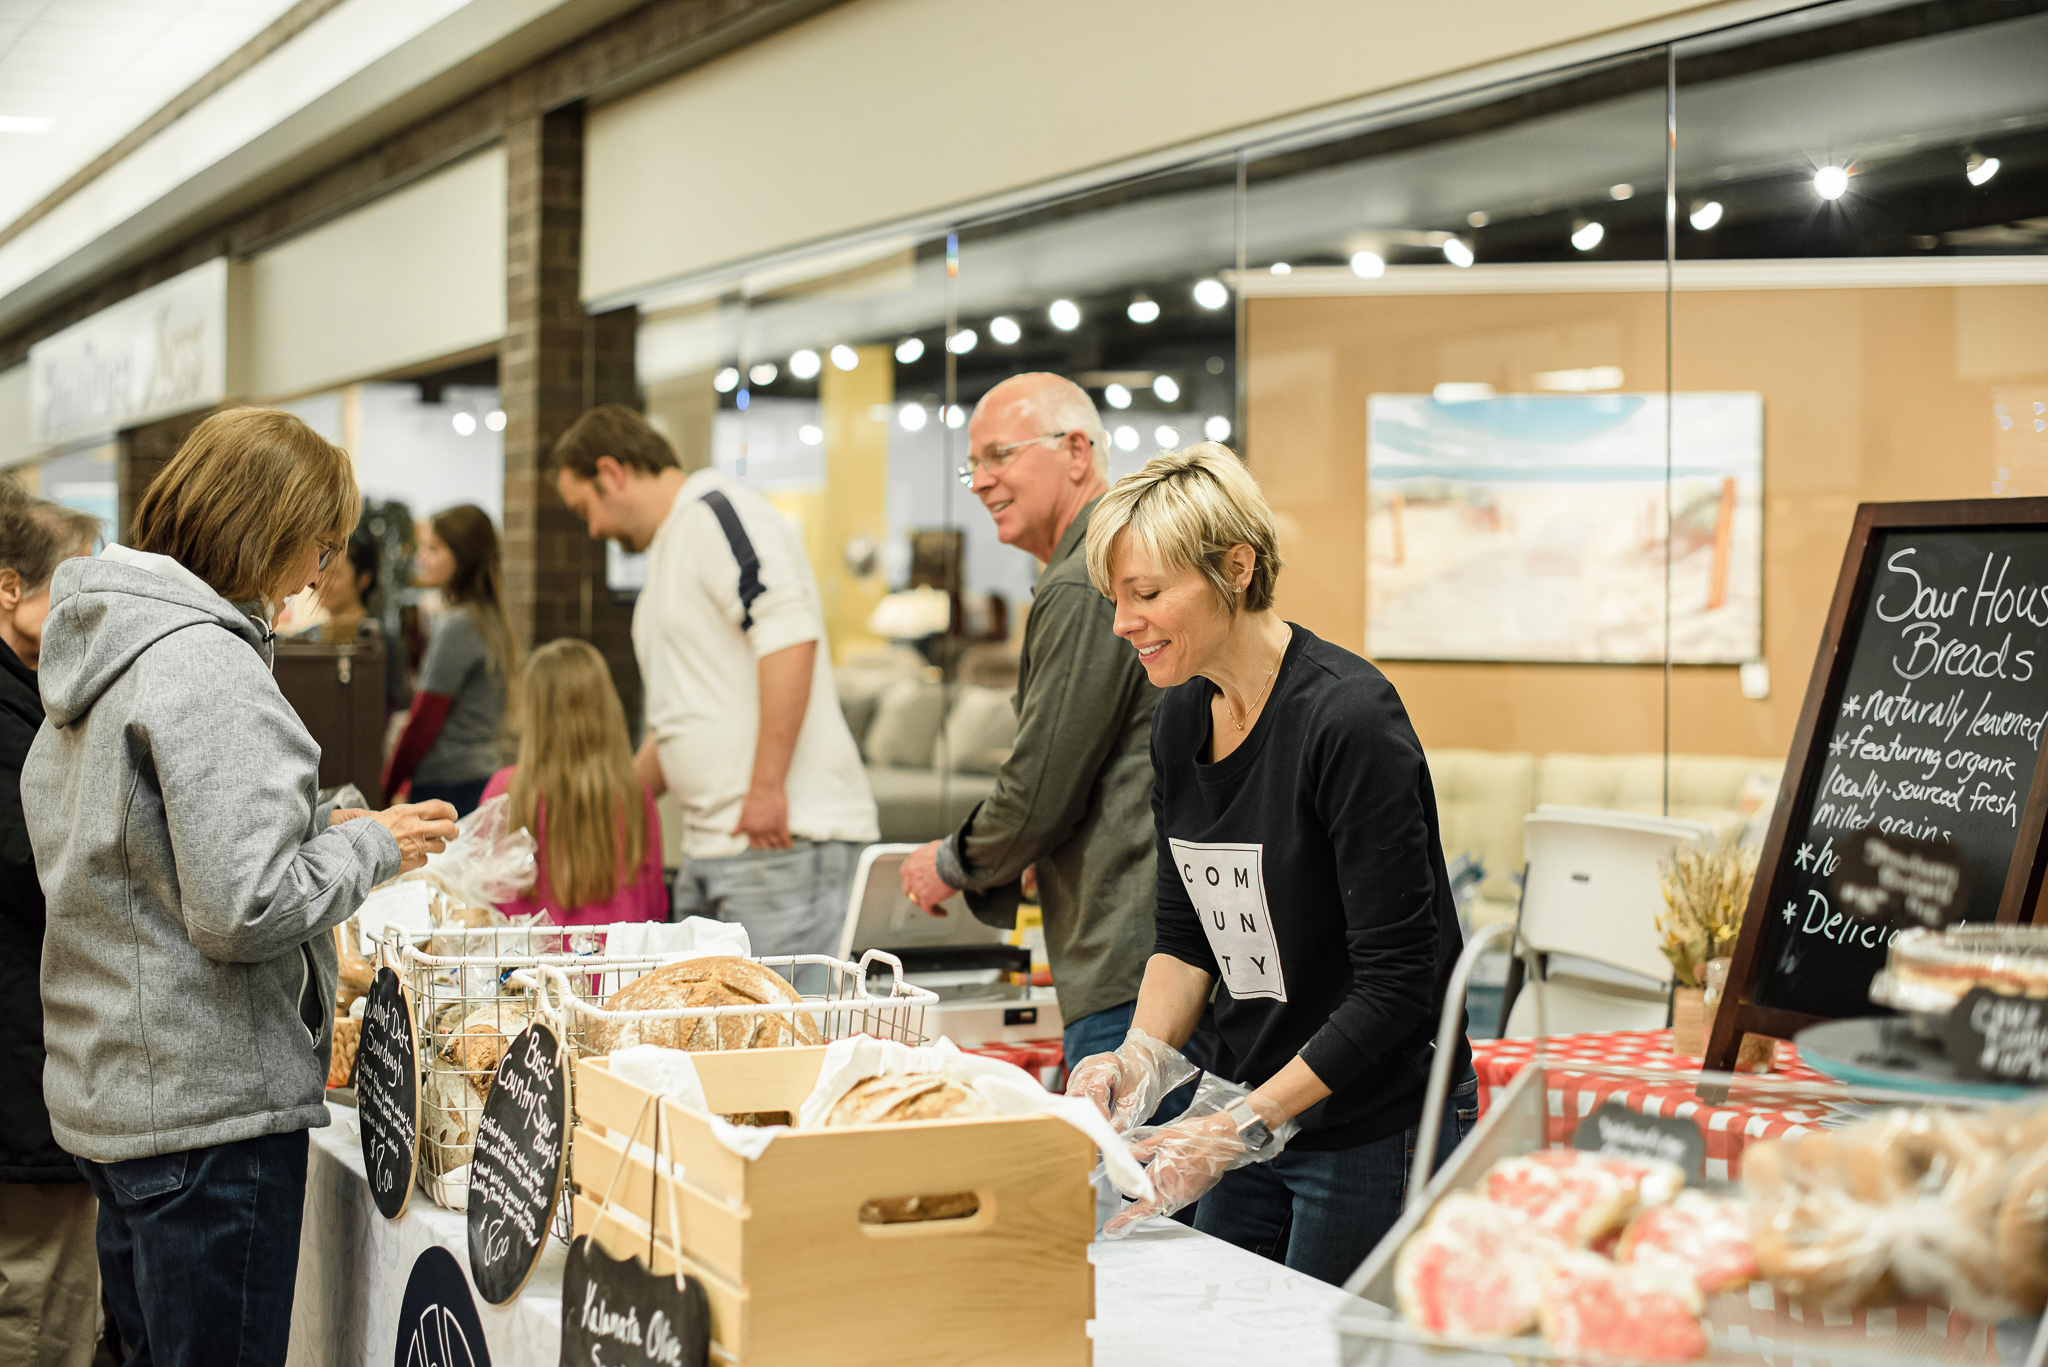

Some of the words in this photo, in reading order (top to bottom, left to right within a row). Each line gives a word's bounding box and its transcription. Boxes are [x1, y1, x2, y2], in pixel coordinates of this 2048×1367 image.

[1876, 547, 1968, 623] Sour
[1893, 621, 2035, 682] Breads
[1861, 682, 1969, 744] naturally
[1965, 689, 2048, 751] leavened
[1849, 724, 1943, 782] featuring
[1945, 749, 2017, 785] organic
[1969, 781, 2017, 828] fresh
[389, 1006, 411, 1055] Date
[524, 1031, 555, 1091] Basic
[498, 1052, 539, 1130] Country
[532, 1094, 558, 1139] Sour
